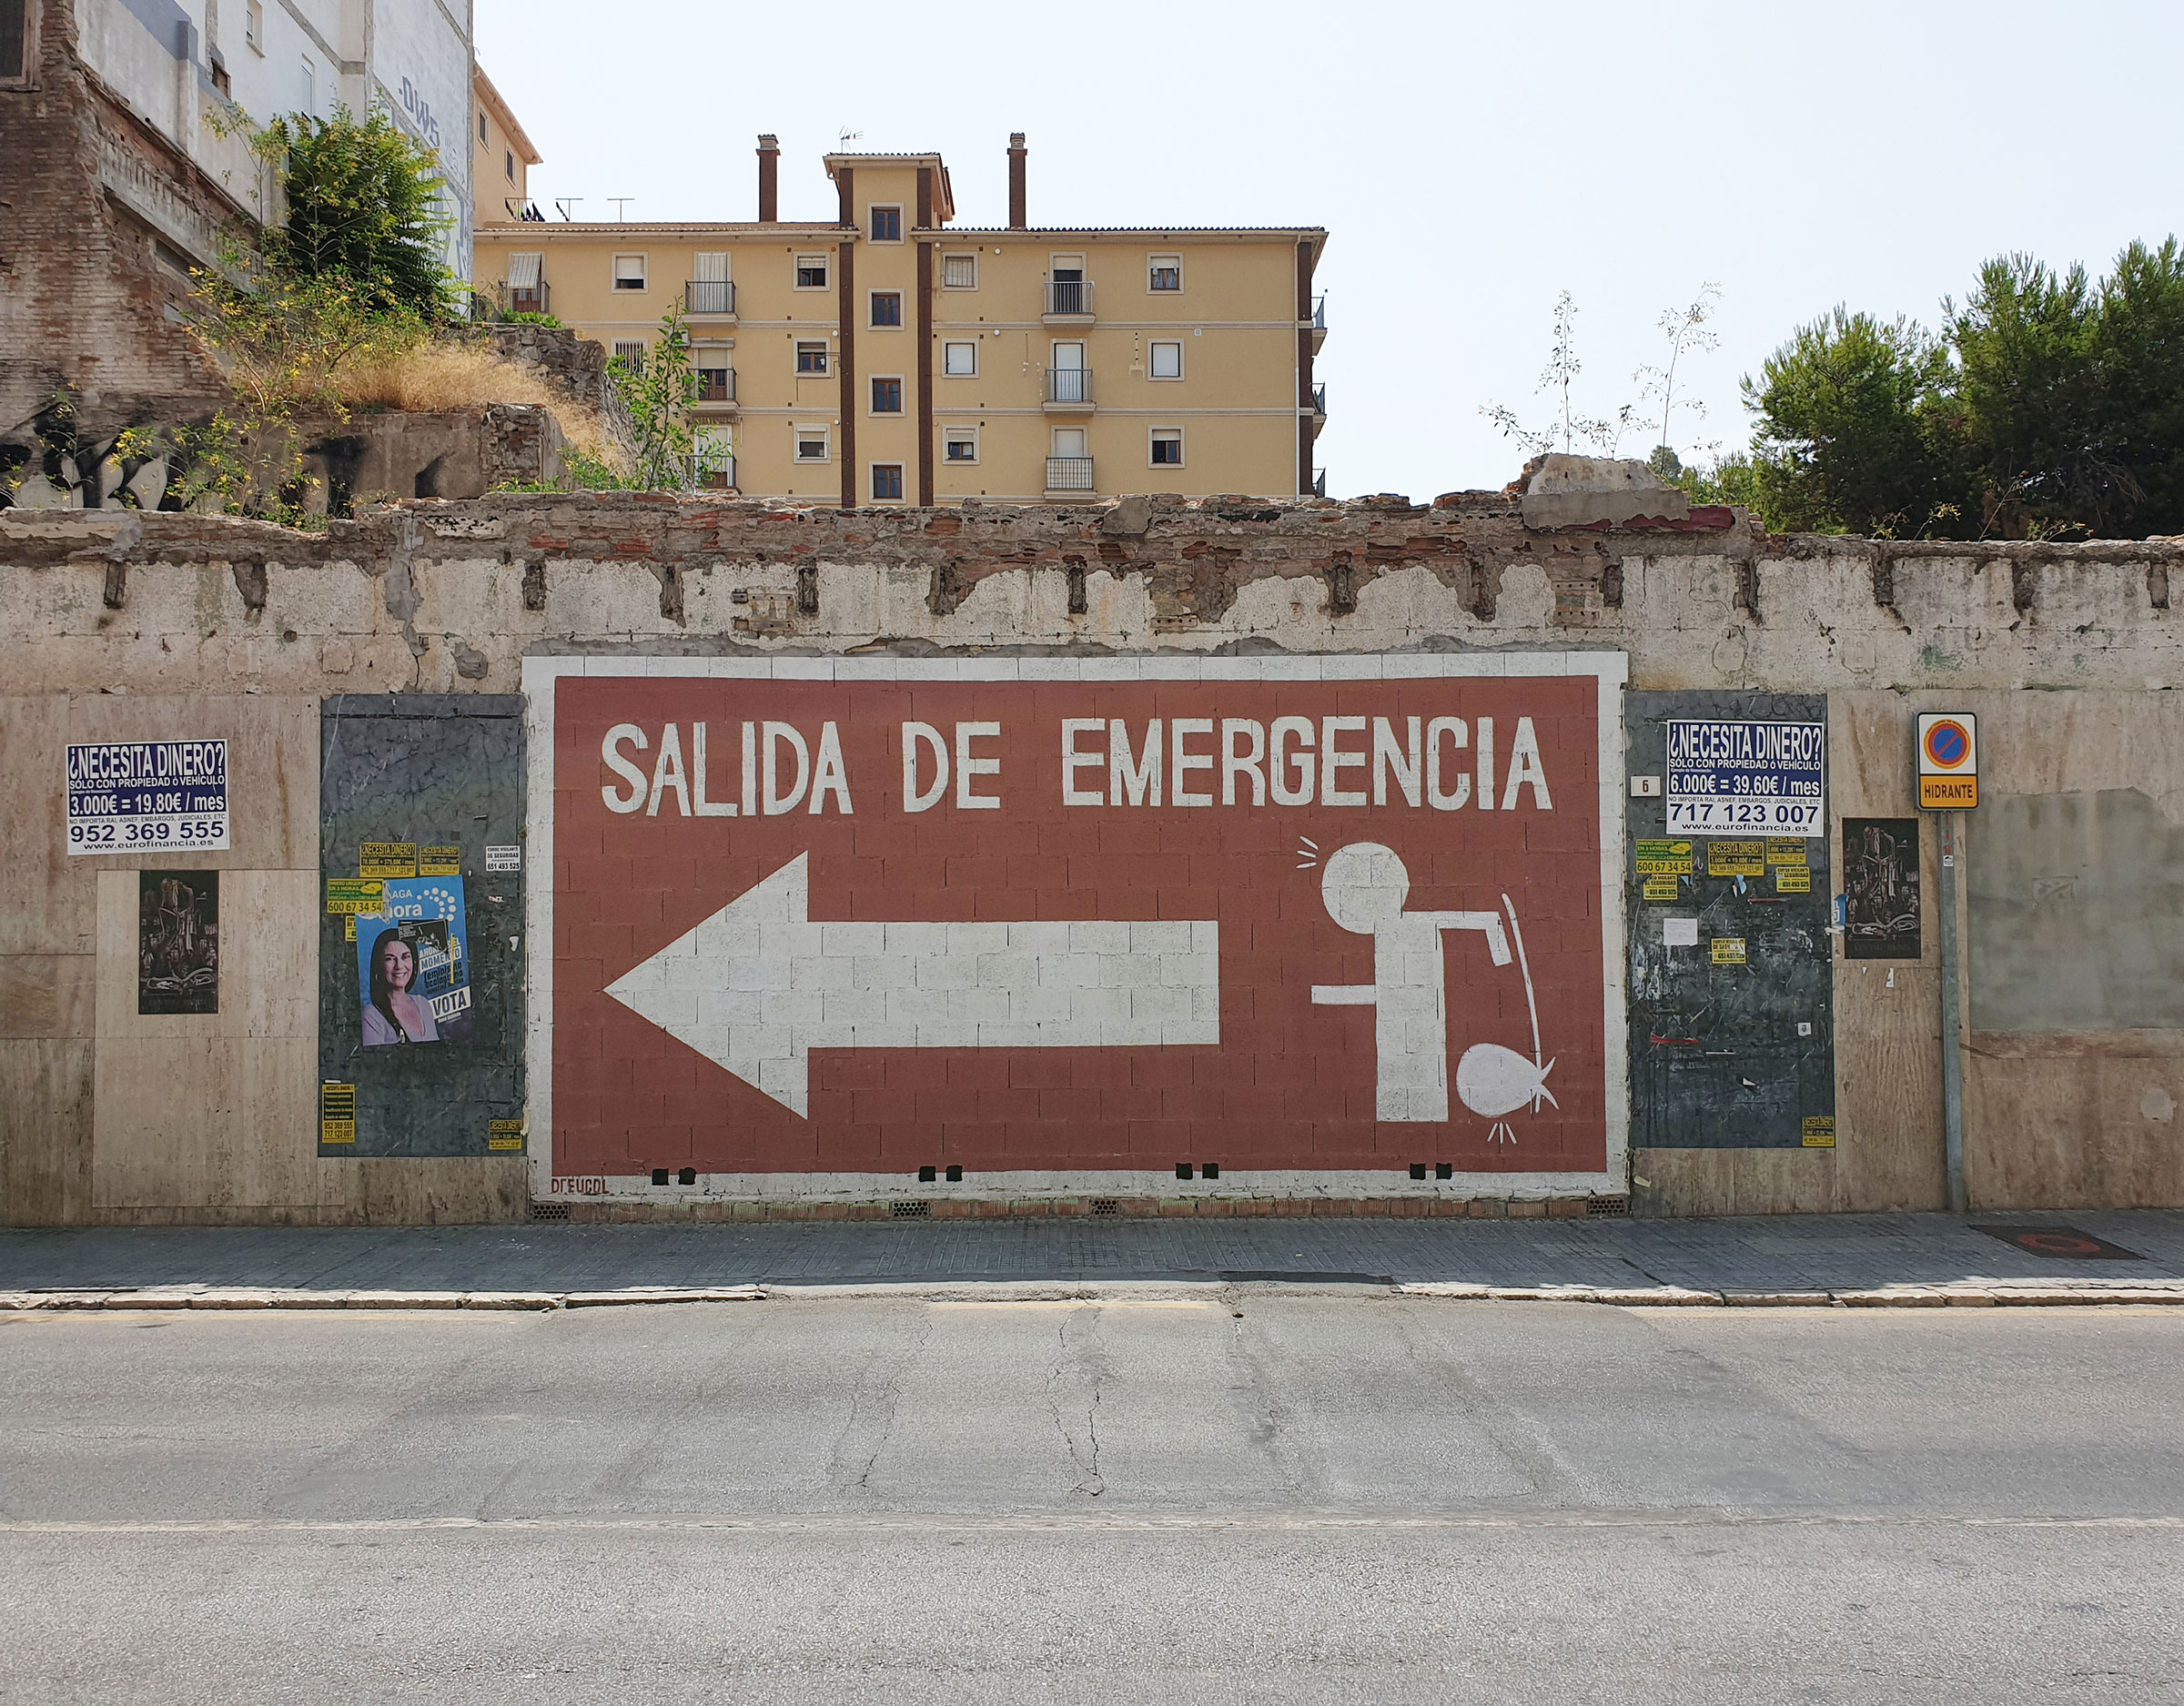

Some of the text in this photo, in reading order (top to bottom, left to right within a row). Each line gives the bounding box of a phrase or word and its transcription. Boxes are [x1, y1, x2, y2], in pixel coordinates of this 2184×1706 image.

[1670, 723, 1821, 761] ¿NECESITA DINERO?
[69, 742, 225, 780] ¿NECESITA DINERO?
[600, 715, 1554, 818] SALIDA DE EMERGENCIA
[1669, 756, 1694, 768] SÓLO
[1695, 759, 1715, 769] CON
[1717, 759, 1768, 770] PROPIEDAD
[1777, 758, 1821, 771] VEHÍCULO
[69, 776, 94, 790] SÓLO
[96, 778, 116, 789] CON
[117, 777, 170, 789] PROPIEDAD
[180, 773, 225, 786] VEHÍCULO
[1643, 780, 1649, 792] 6
[1670, 774, 1820, 796] 6.000€ = 39,60€ / mes
[1924, 784, 1973, 799] HIDRANTE
[70, 792, 225, 815] 3.000€ = 19,80€ / mes
[1670, 803, 1818, 824] 717 123 007
[70, 821, 225, 843] 952 369 555
[1682, 823, 1808, 833] www.eurofinancia.es
[84, 838, 214, 851] www.eurofinancia.es
[1637, 862, 1691, 872] 600 67 34 54
[328, 902, 382, 912] 600 67 34 54
[420, 947, 460, 971] MOMENO
[432, 990, 467, 1016] VOTA
